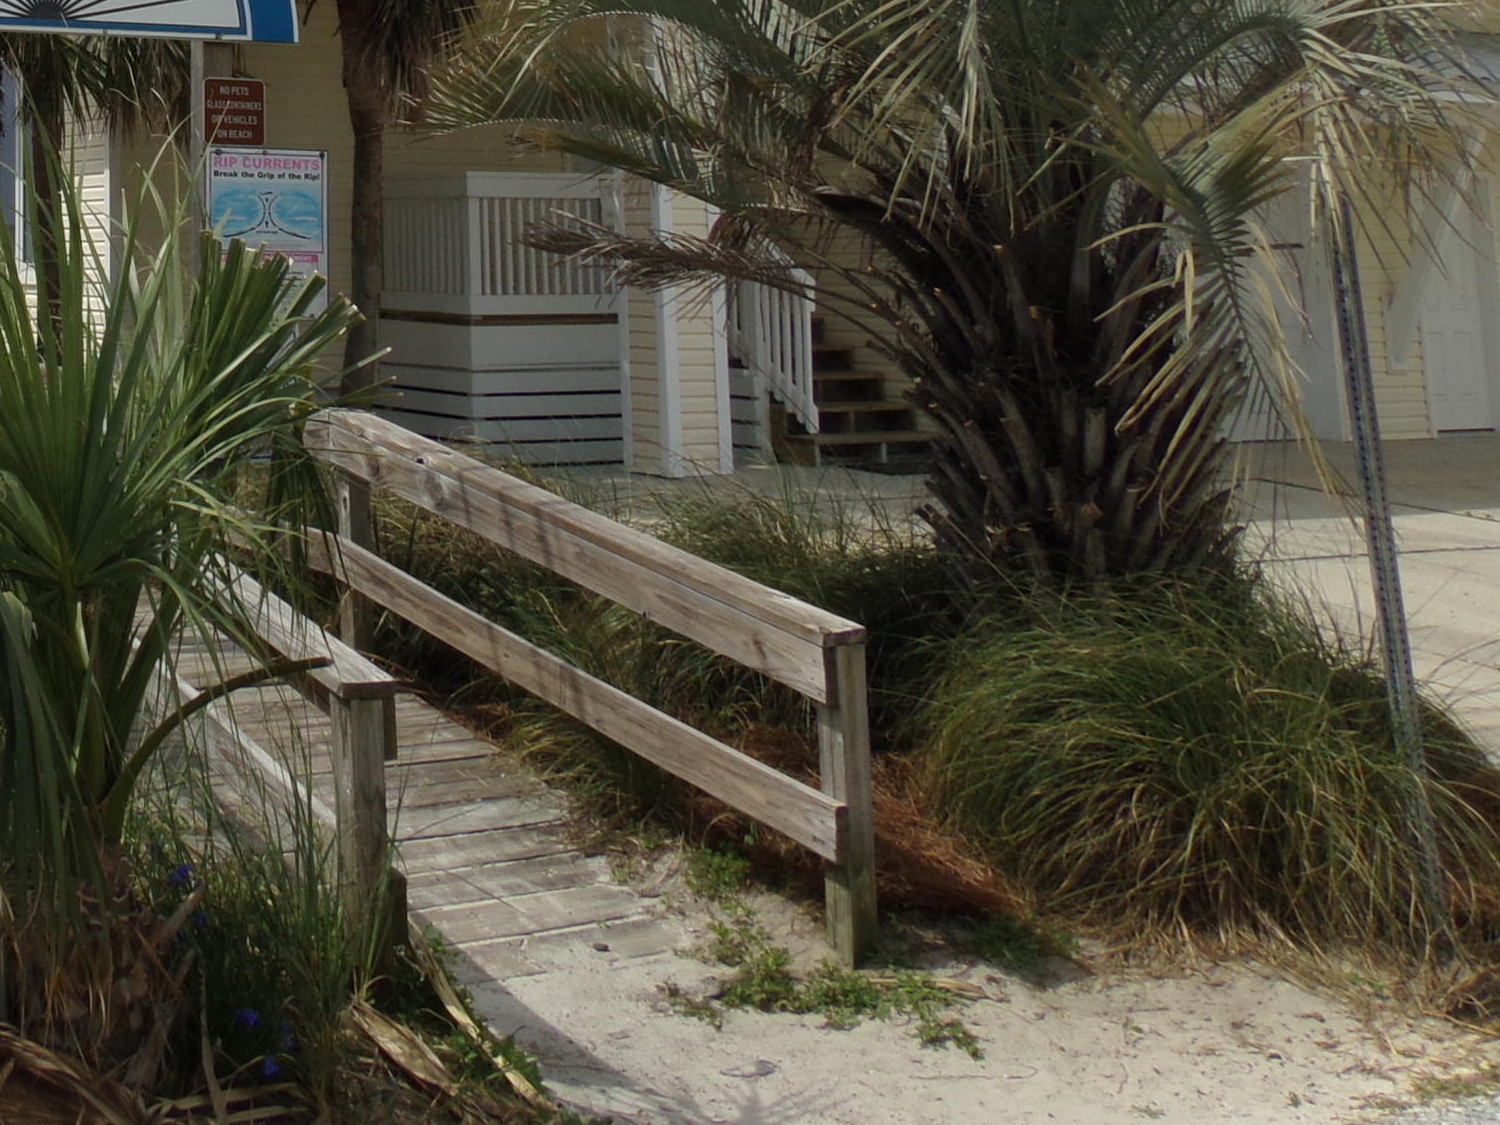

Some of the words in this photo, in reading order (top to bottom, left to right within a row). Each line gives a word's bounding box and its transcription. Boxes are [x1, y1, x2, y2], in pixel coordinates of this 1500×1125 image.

[219, 86, 230, 95] NO
[231, 86, 249, 96] PETS
[222, 115, 258, 125] VEHICLES
[228, 130, 253, 139] BEACH
[213, 156, 238, 169] RIP
[242, 157, 320, 171] CURRENTS
[213, 170, 238, 178] Break
[257, 171, 275, 180] Grip
[288, 172, 301, 180] the
[304, 173, 320, 181] Rip!
